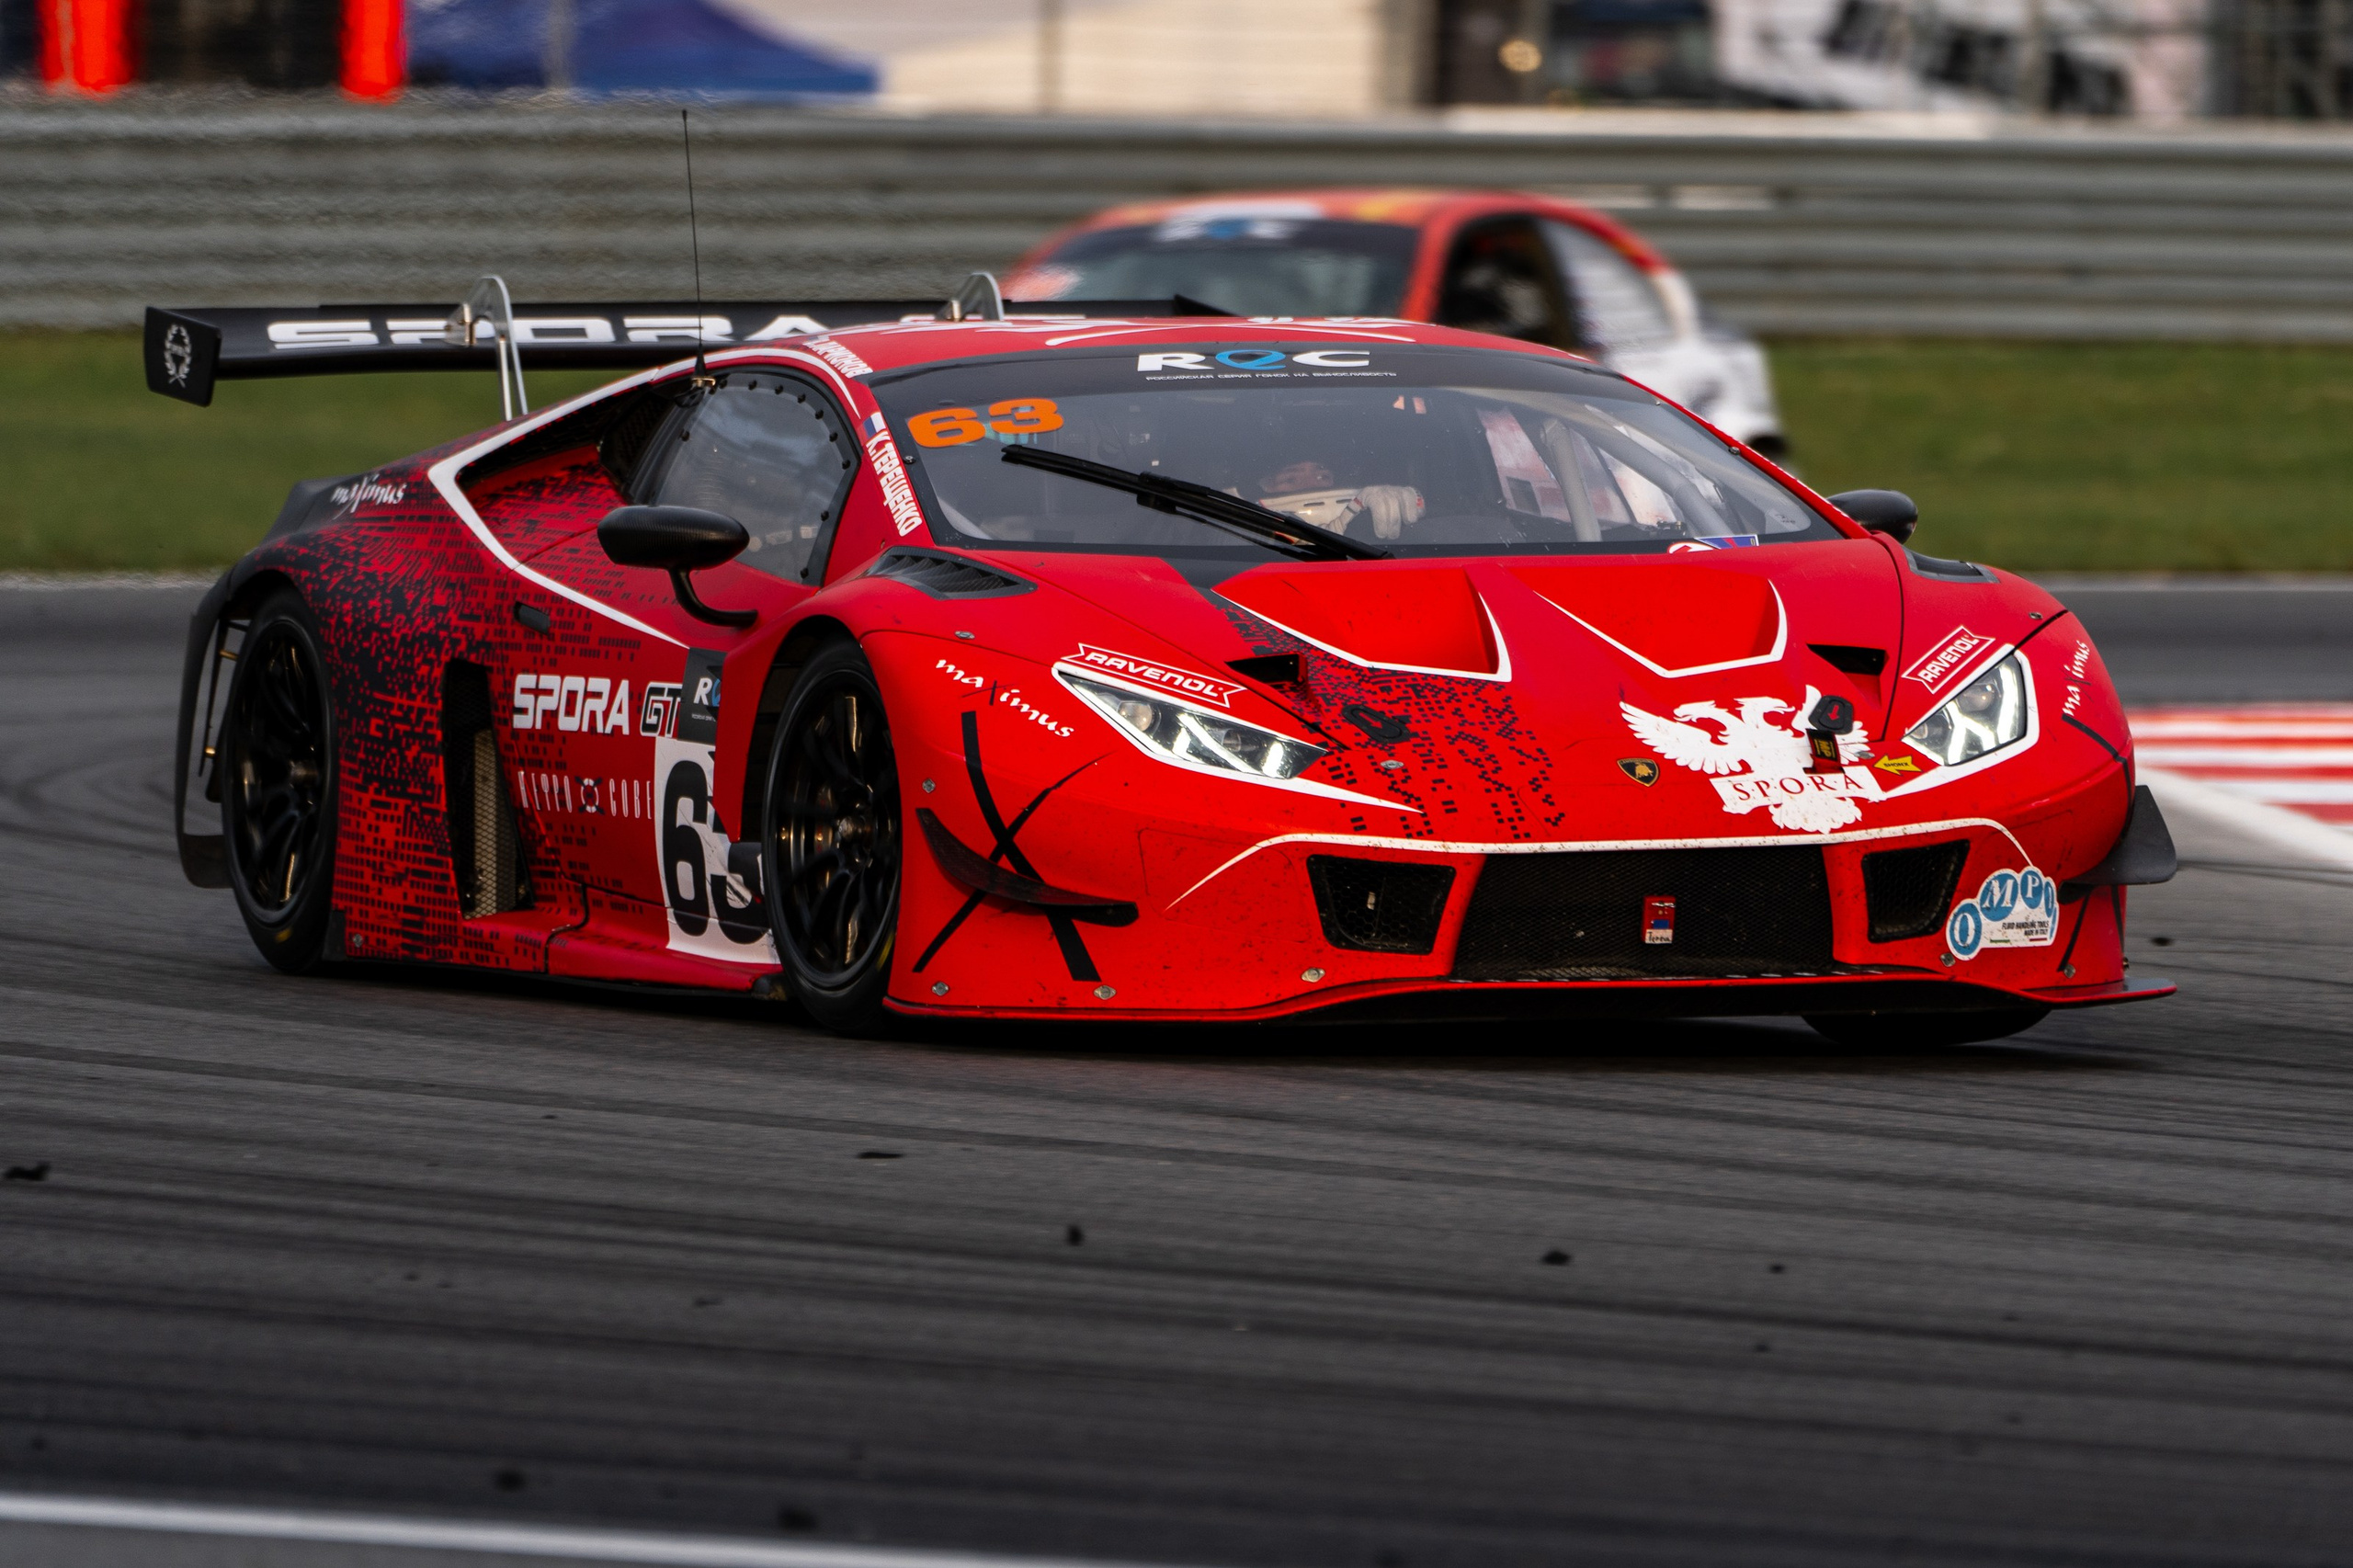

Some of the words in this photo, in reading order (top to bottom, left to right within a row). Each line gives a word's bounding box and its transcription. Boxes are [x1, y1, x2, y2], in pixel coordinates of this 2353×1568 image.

[267, 316, 831, 349] SPORA
[907, 397, 1064, 449] 63
[1084, 651, 1221, 699] RAVENOL
[1916, 635, 1980, 683] RAVENOL
[513, 674, 630, 735] SPORA
